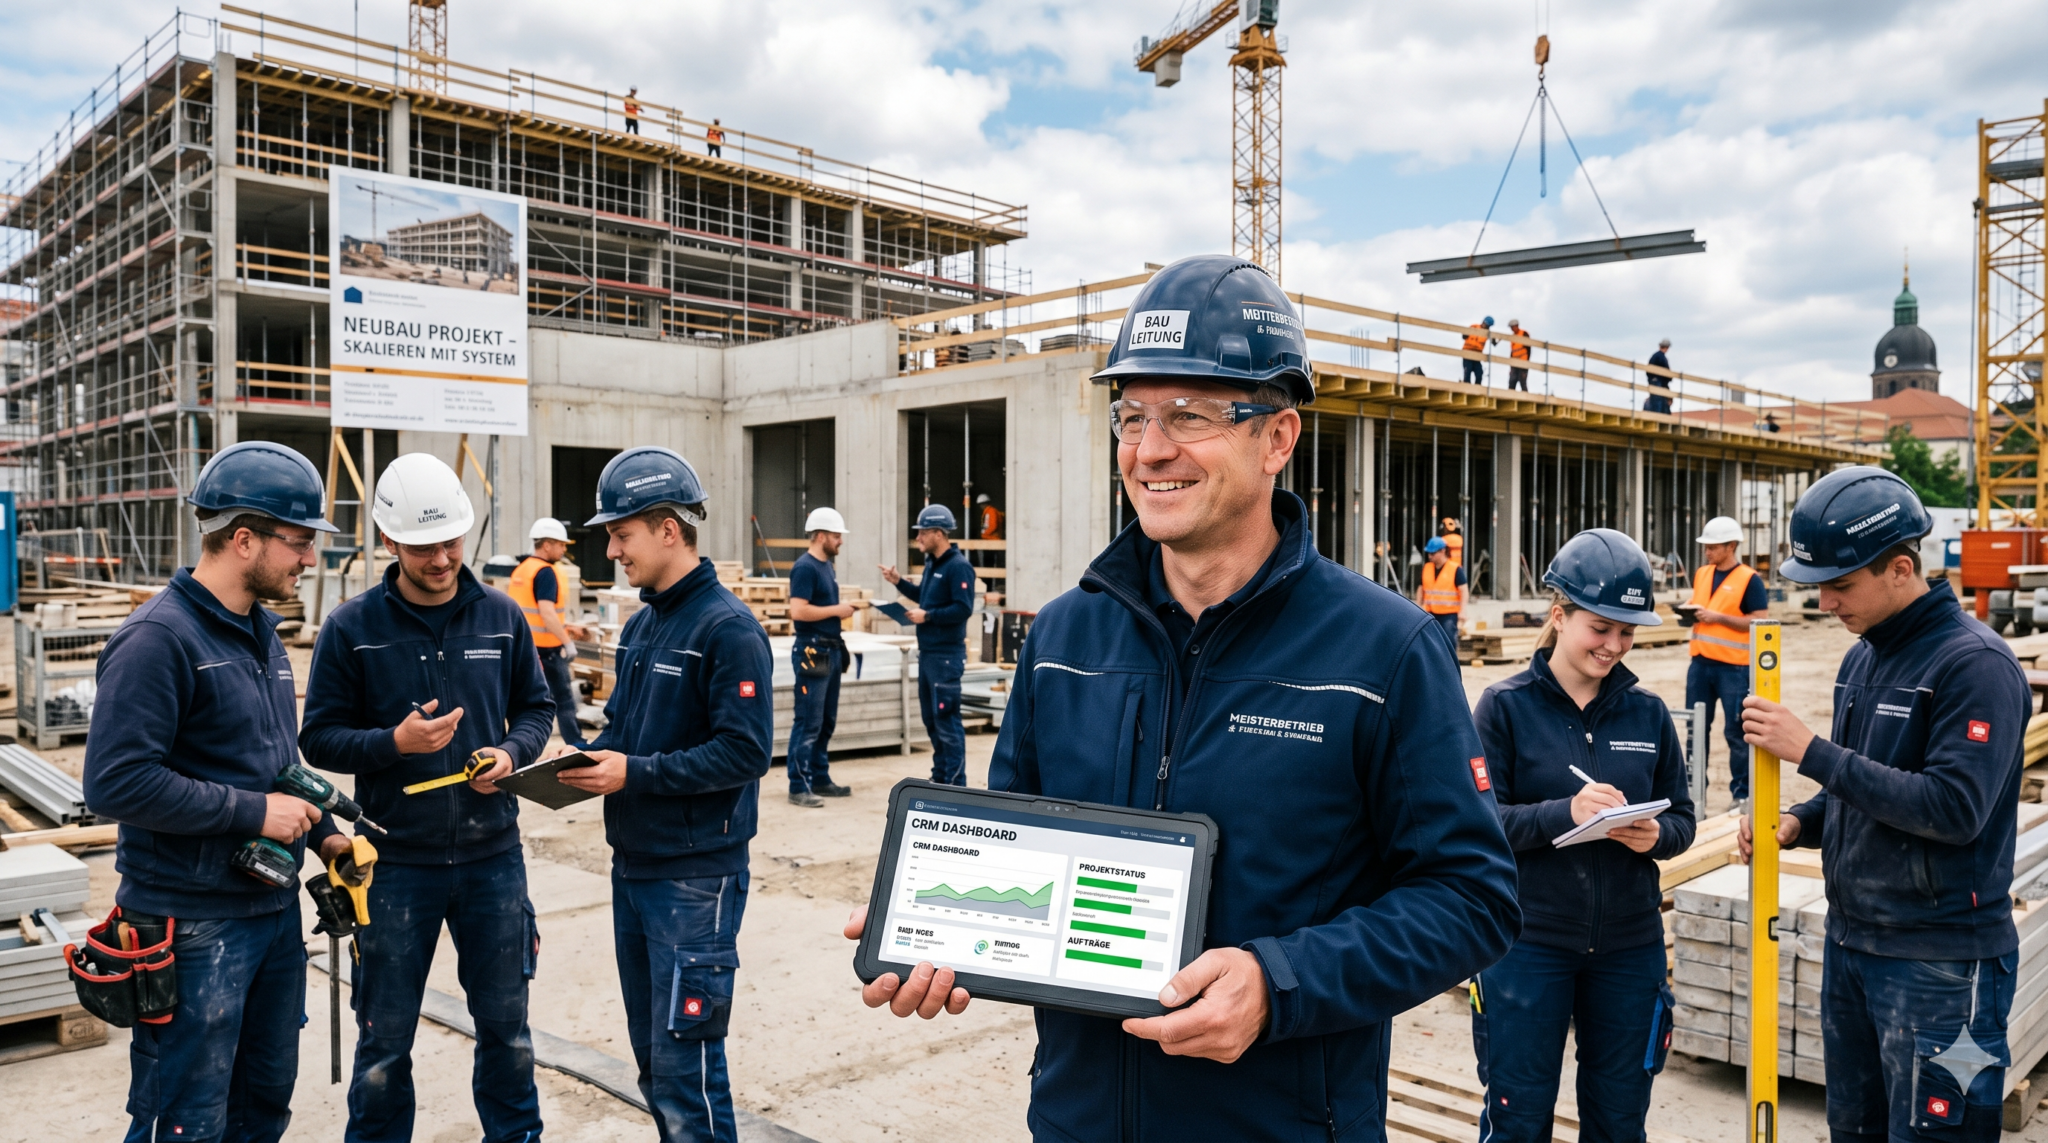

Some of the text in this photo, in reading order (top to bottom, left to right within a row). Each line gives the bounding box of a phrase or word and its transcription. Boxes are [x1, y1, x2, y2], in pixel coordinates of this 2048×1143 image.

[1144, 315, 1170, 328] BAU
[344, 316, 421, 338] NEUBAU
[429, 324, 503, 346] PROJEKT
[1131, 331, 1182, 345] LEITUNG
[344, 339, 516, 366] SKALIEREN MIT SYSTEM
[418, 513, 447, 523] LEITUNG
[1229, 713, 1324, 733] MEISTERBETRIEB
[911, 818, 1017, 841] CRM DASHBOARD
[913, 841, 980, 857] CRM DASHBOARD
[1079, 863, 1146, 879] PROJEKTSTATUS
[1067, 937, 1111, 949] AUFTRÄGE
